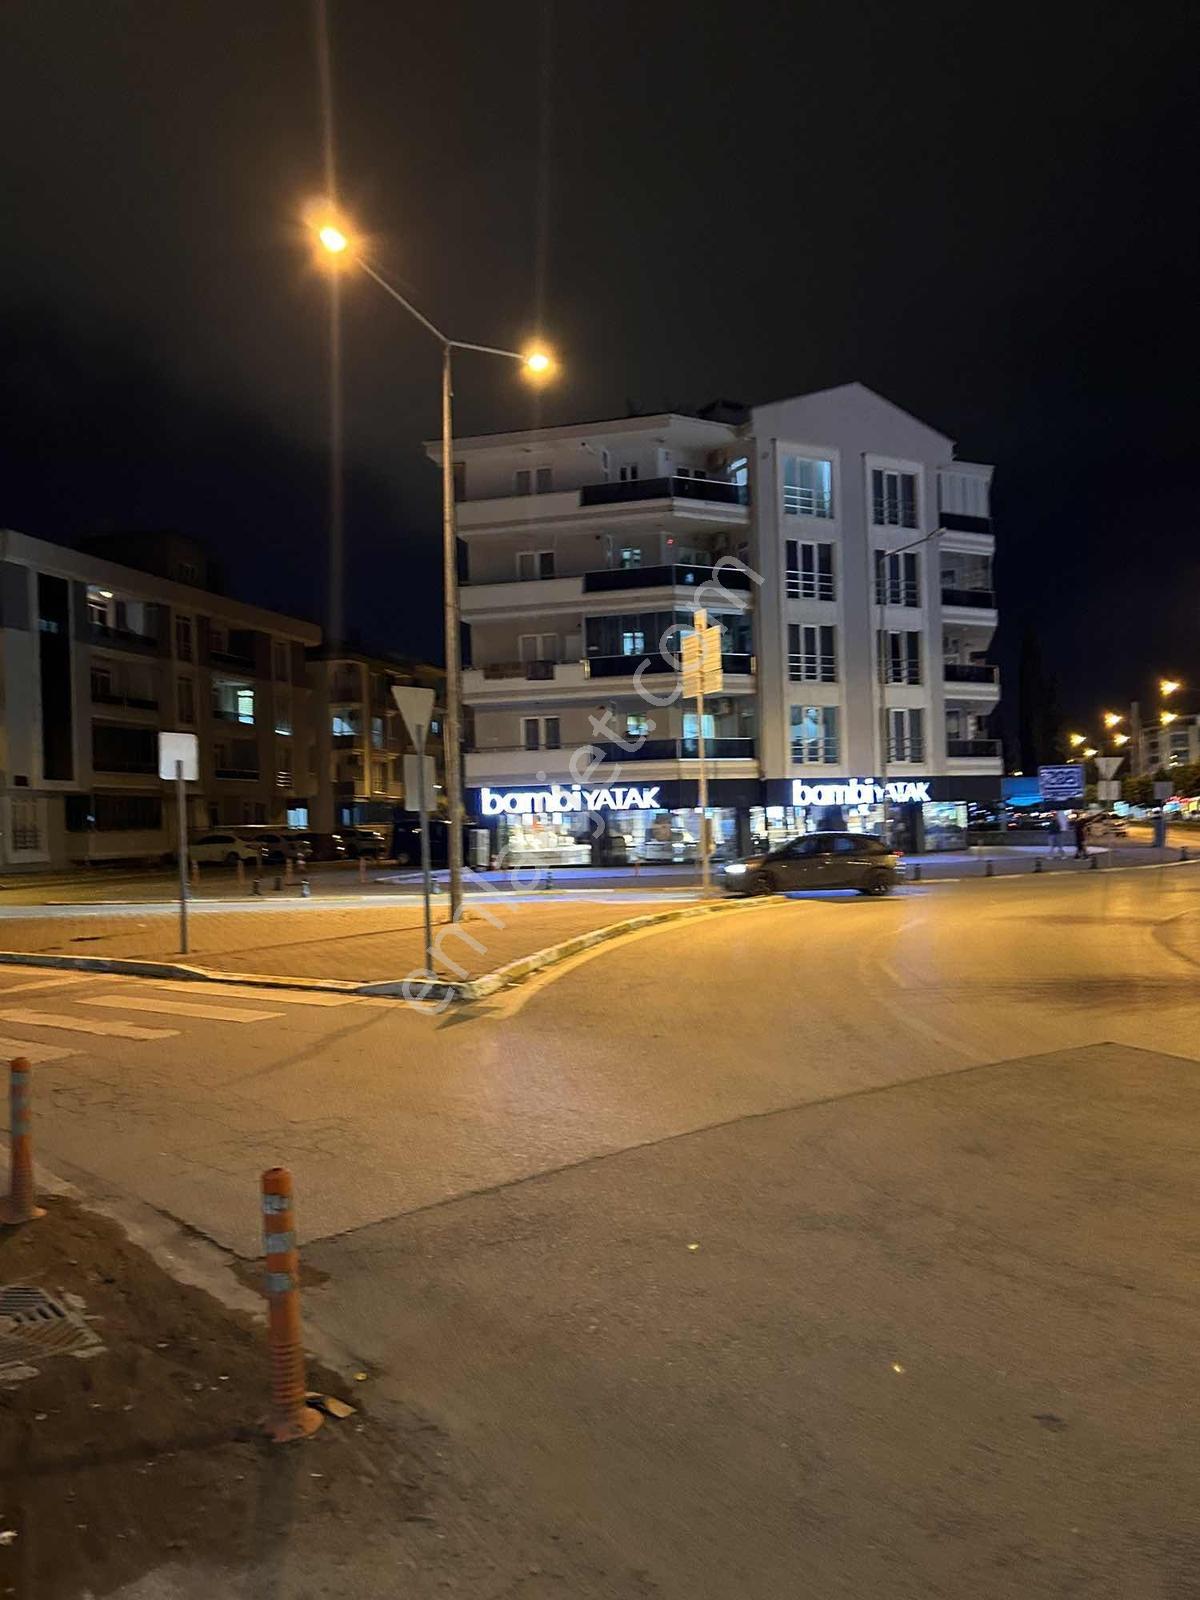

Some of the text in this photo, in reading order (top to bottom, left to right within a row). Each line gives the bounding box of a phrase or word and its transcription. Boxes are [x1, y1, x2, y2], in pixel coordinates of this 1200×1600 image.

[481, 785, 661, 815] bambi YATAK
[793, 778, 874, 806] bambi
